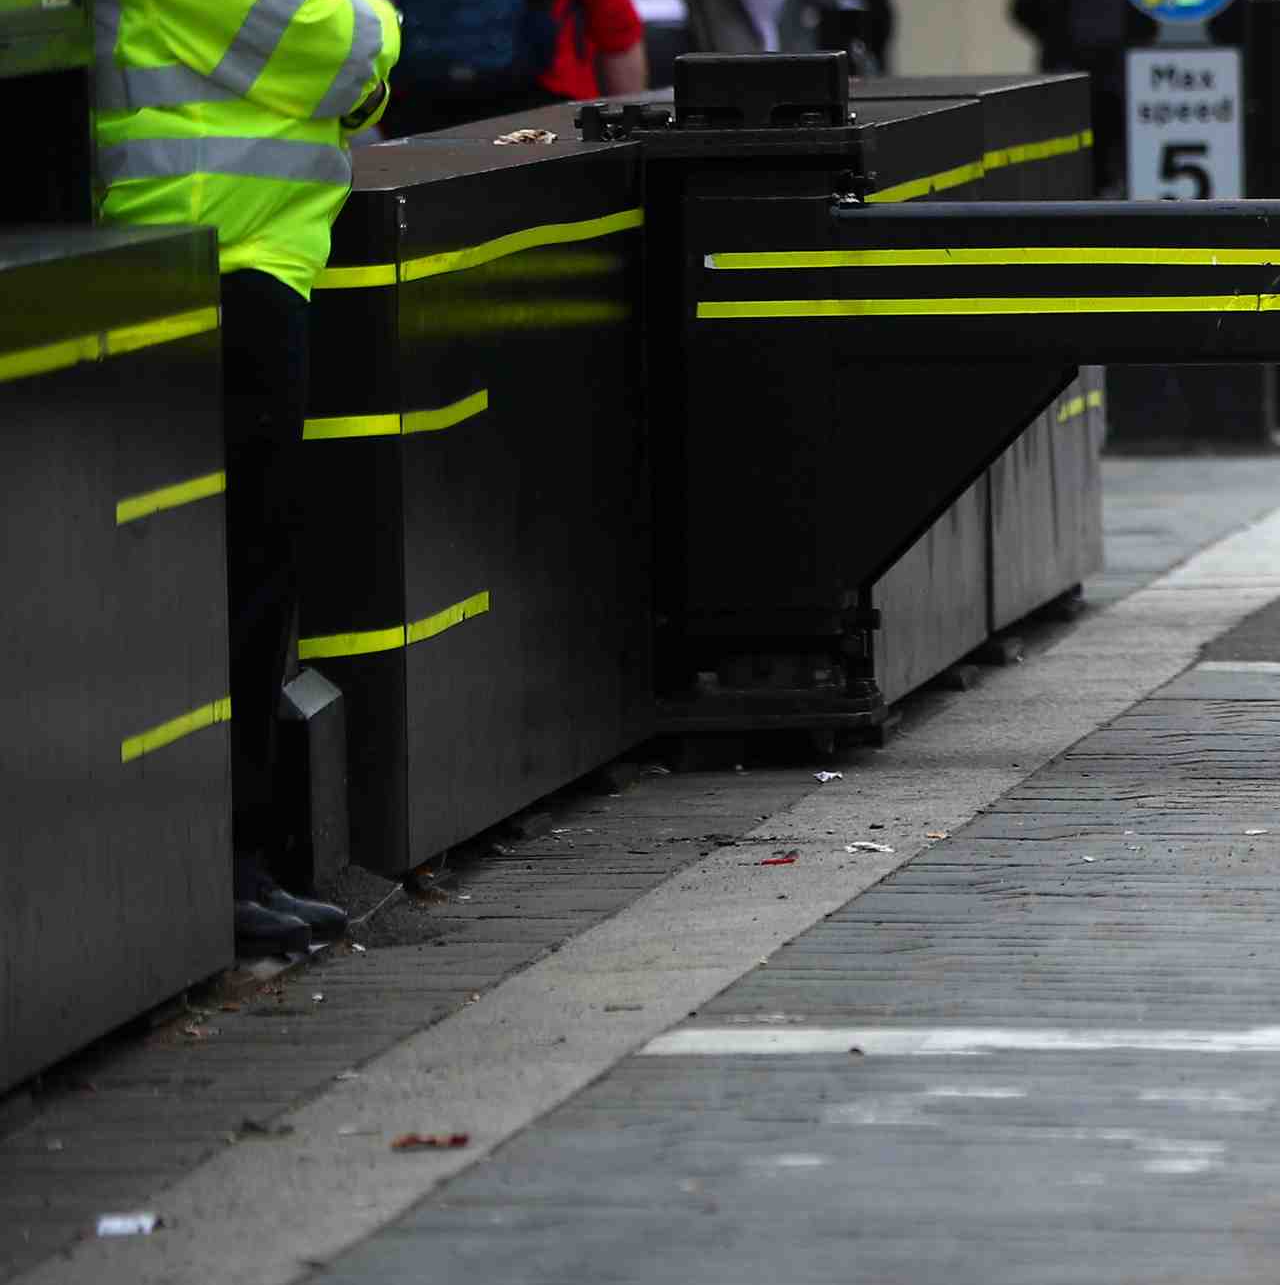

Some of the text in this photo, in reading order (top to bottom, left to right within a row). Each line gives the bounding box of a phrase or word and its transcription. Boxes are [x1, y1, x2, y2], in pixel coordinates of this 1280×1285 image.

[1151, 66, 1216, 90] Max
[1137, 98, 1234, 127] speed
[1159, 143, 1213, 201] 5
